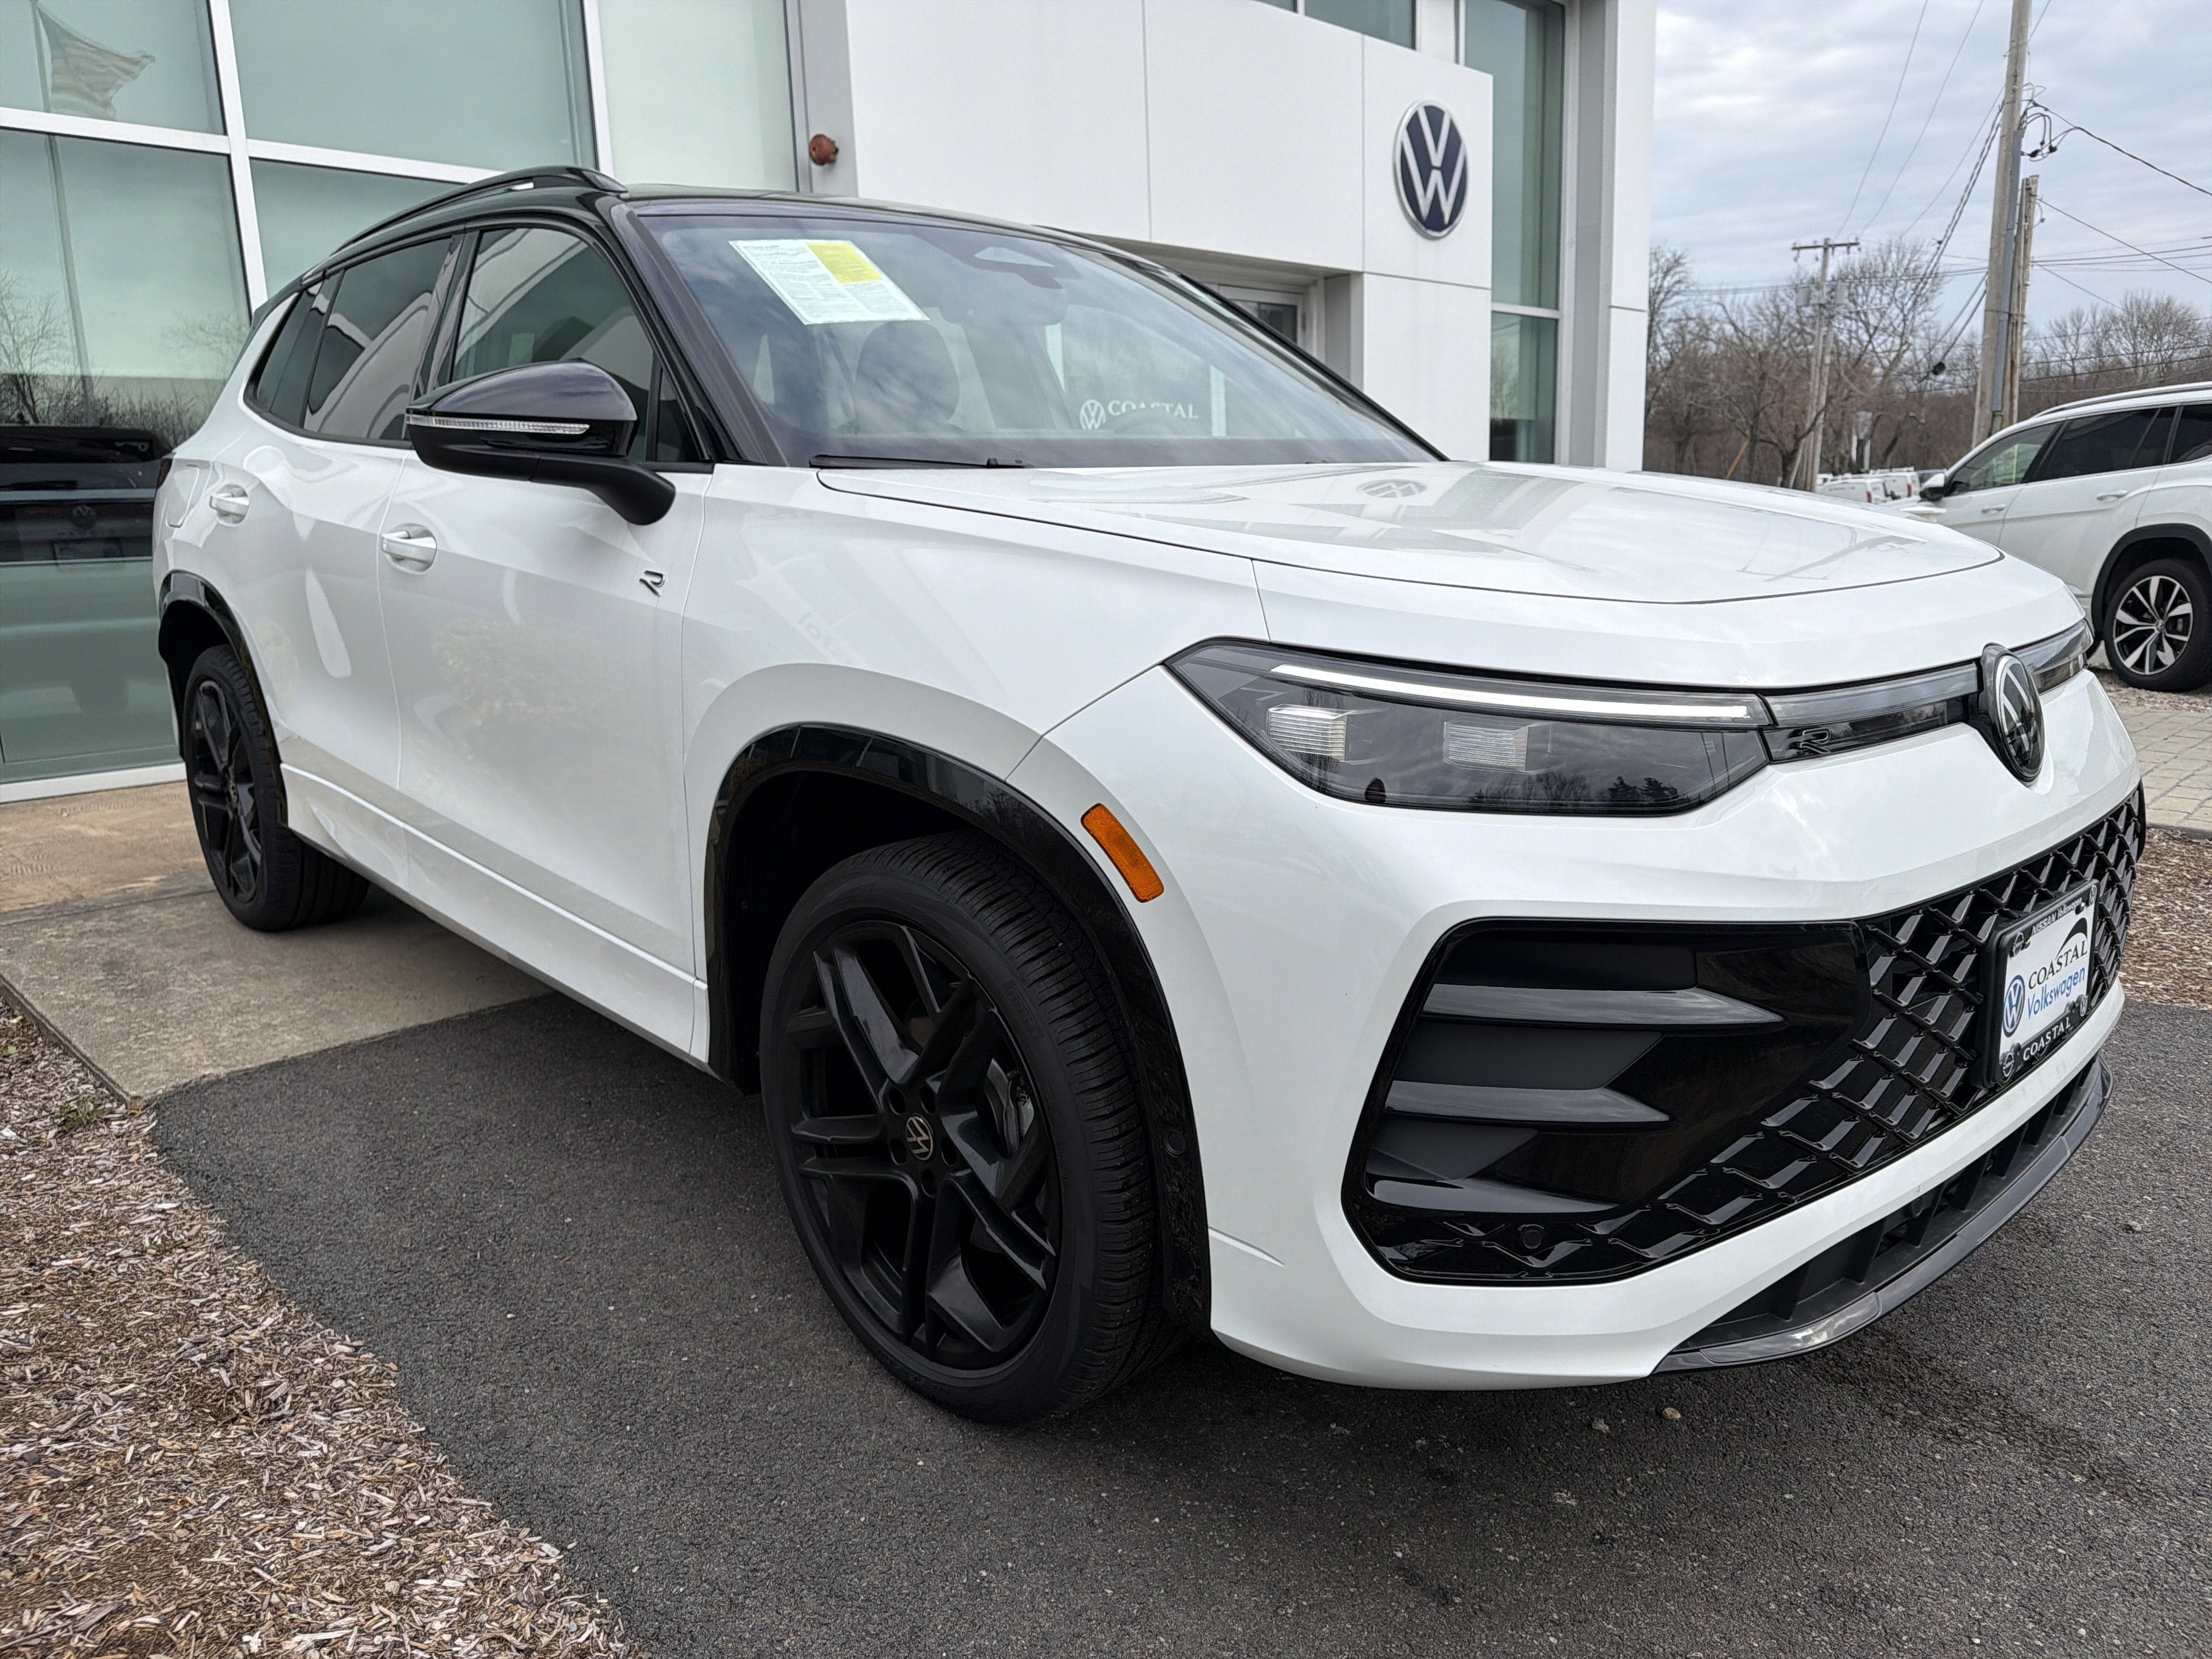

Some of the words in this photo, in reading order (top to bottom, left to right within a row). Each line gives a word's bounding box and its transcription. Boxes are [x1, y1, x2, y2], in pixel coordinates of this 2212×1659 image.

[1800, 727, 1831, 754] R
[2032, 912, 2057, 936] NISSAN
[2029, 940, 2087, 990] COASTAL
[2028, 967, 2085, 1019] Volkswagen
[2023, 1017, 2071, 1061] COASTAL
